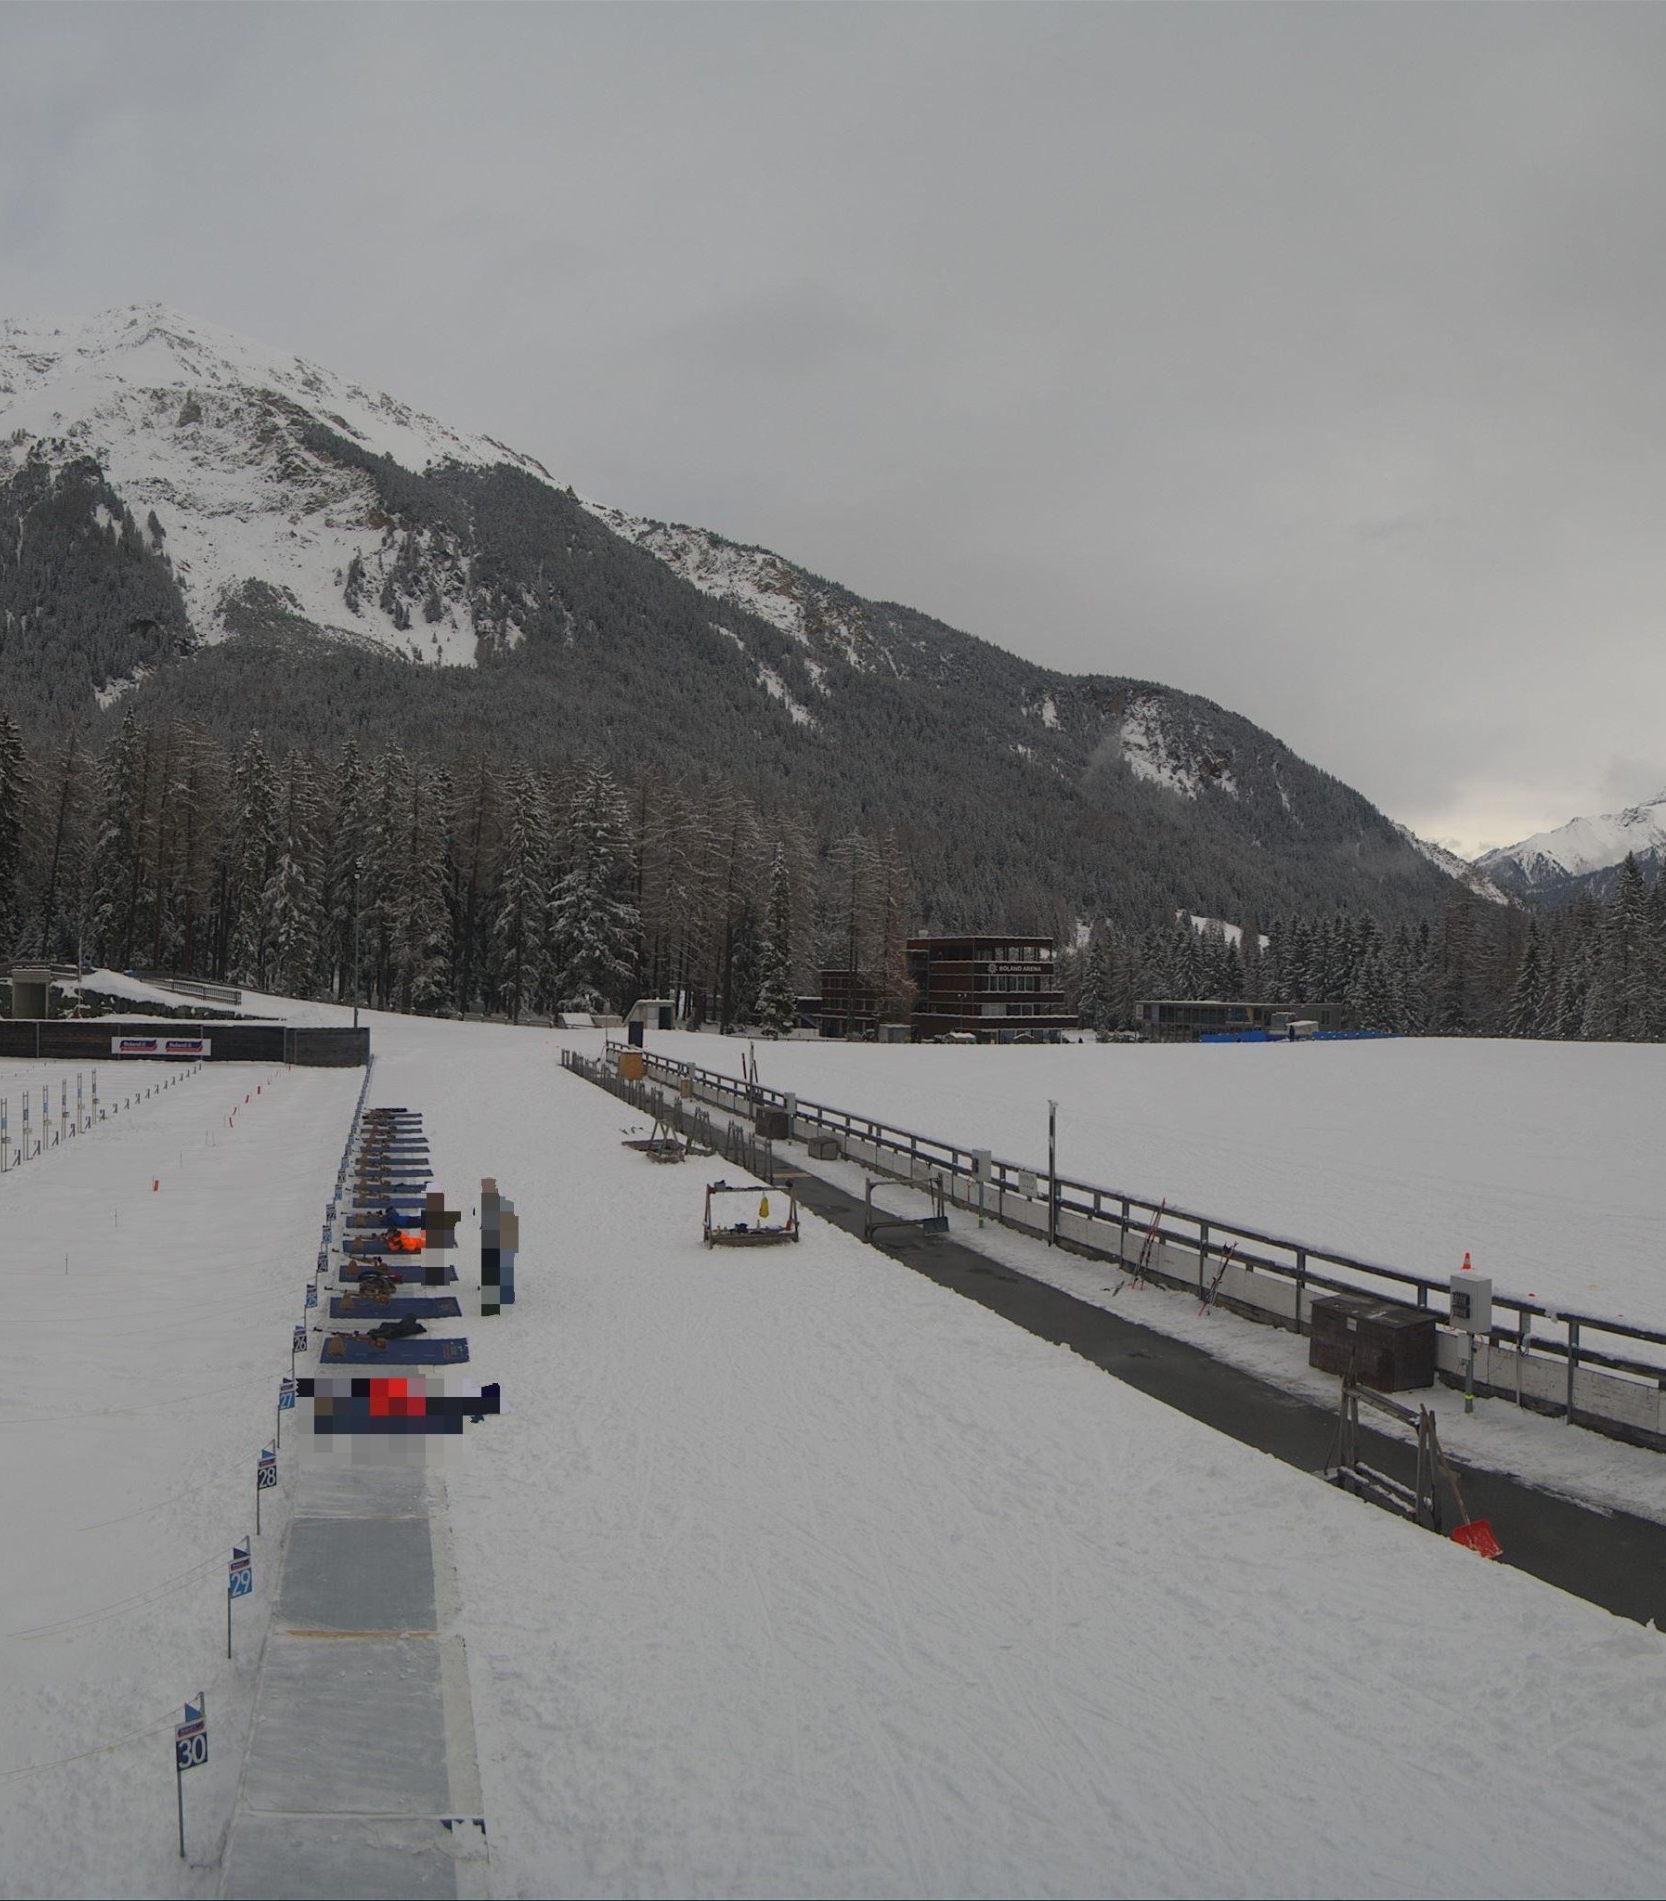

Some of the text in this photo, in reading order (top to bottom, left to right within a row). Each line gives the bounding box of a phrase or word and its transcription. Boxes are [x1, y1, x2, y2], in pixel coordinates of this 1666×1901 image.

[294, 1336, 307, 1352] 26
[279, 1392, 293, 1409] 27
[258, 1467, 276, 1488] 28
[231, 1569, 252, 1596] 29
[178, 1734, 207, 1770] 30
